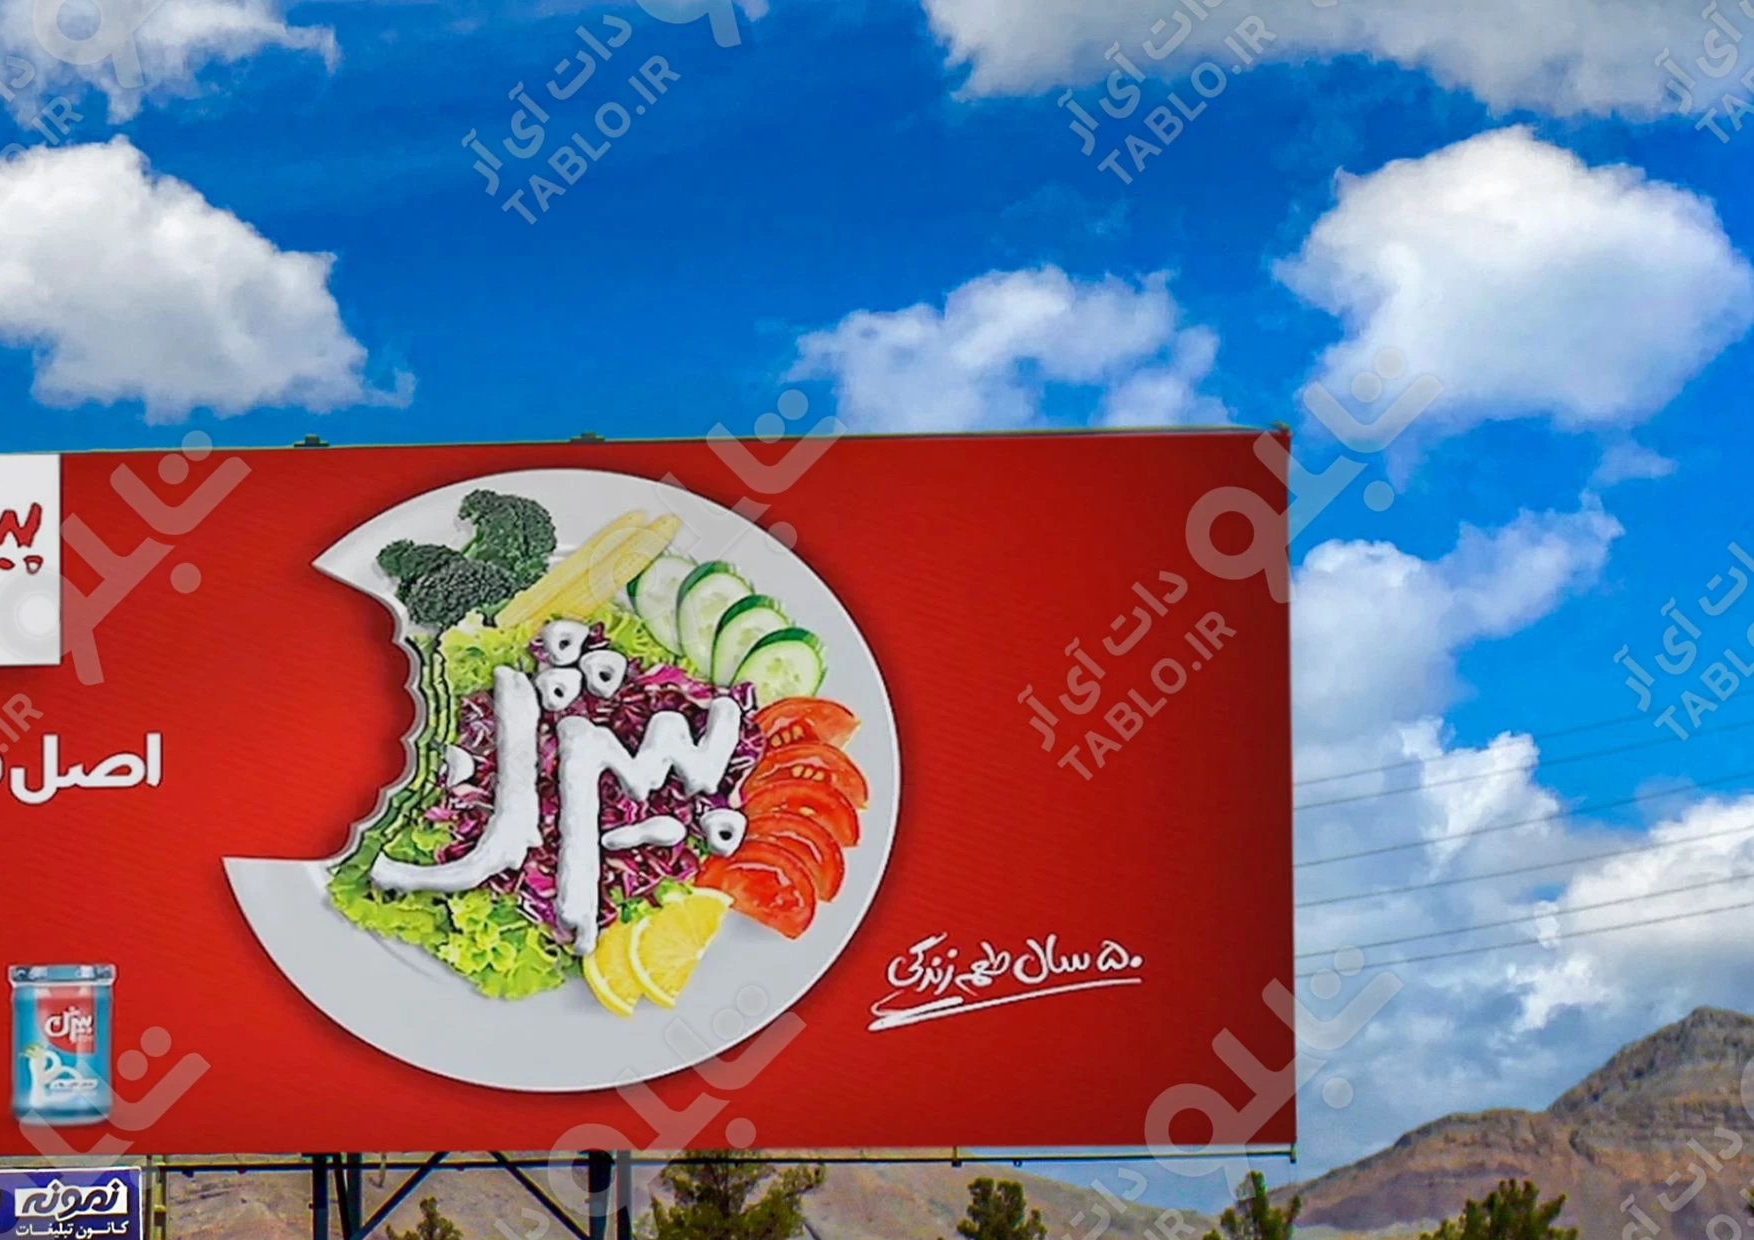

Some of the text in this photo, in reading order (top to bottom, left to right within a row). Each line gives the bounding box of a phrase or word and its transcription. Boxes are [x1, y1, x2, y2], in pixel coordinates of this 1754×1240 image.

[9, 732, 163, 805] اصل
[1013, 934, 1091, 984] سال
[16, 1220, 129, 1240] کانون تبلیغات
